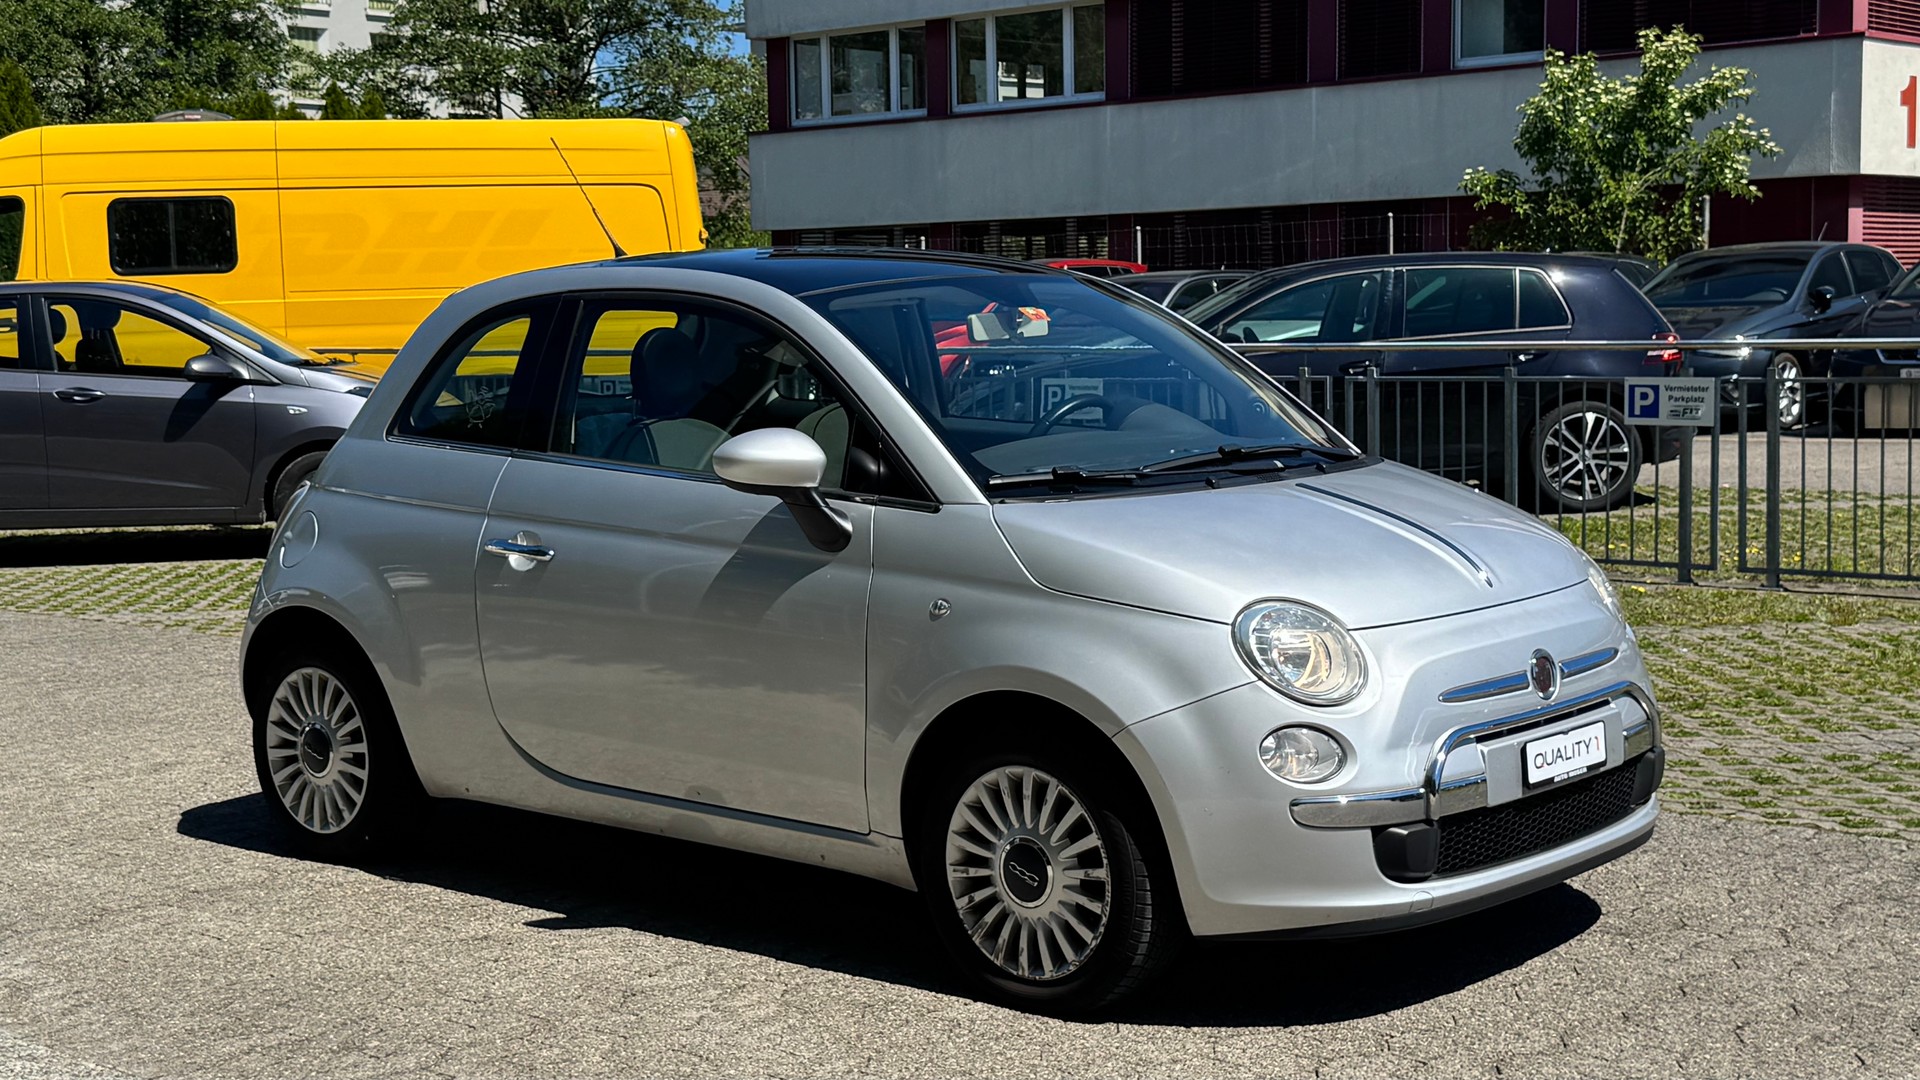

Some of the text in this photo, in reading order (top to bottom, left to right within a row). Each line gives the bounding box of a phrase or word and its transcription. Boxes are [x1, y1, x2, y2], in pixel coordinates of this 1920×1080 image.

[1900, 75, 1917, 149] 1
[1634, 386, 1655, 416] P
[1668, 394, 1705, 404] Parkplatz
